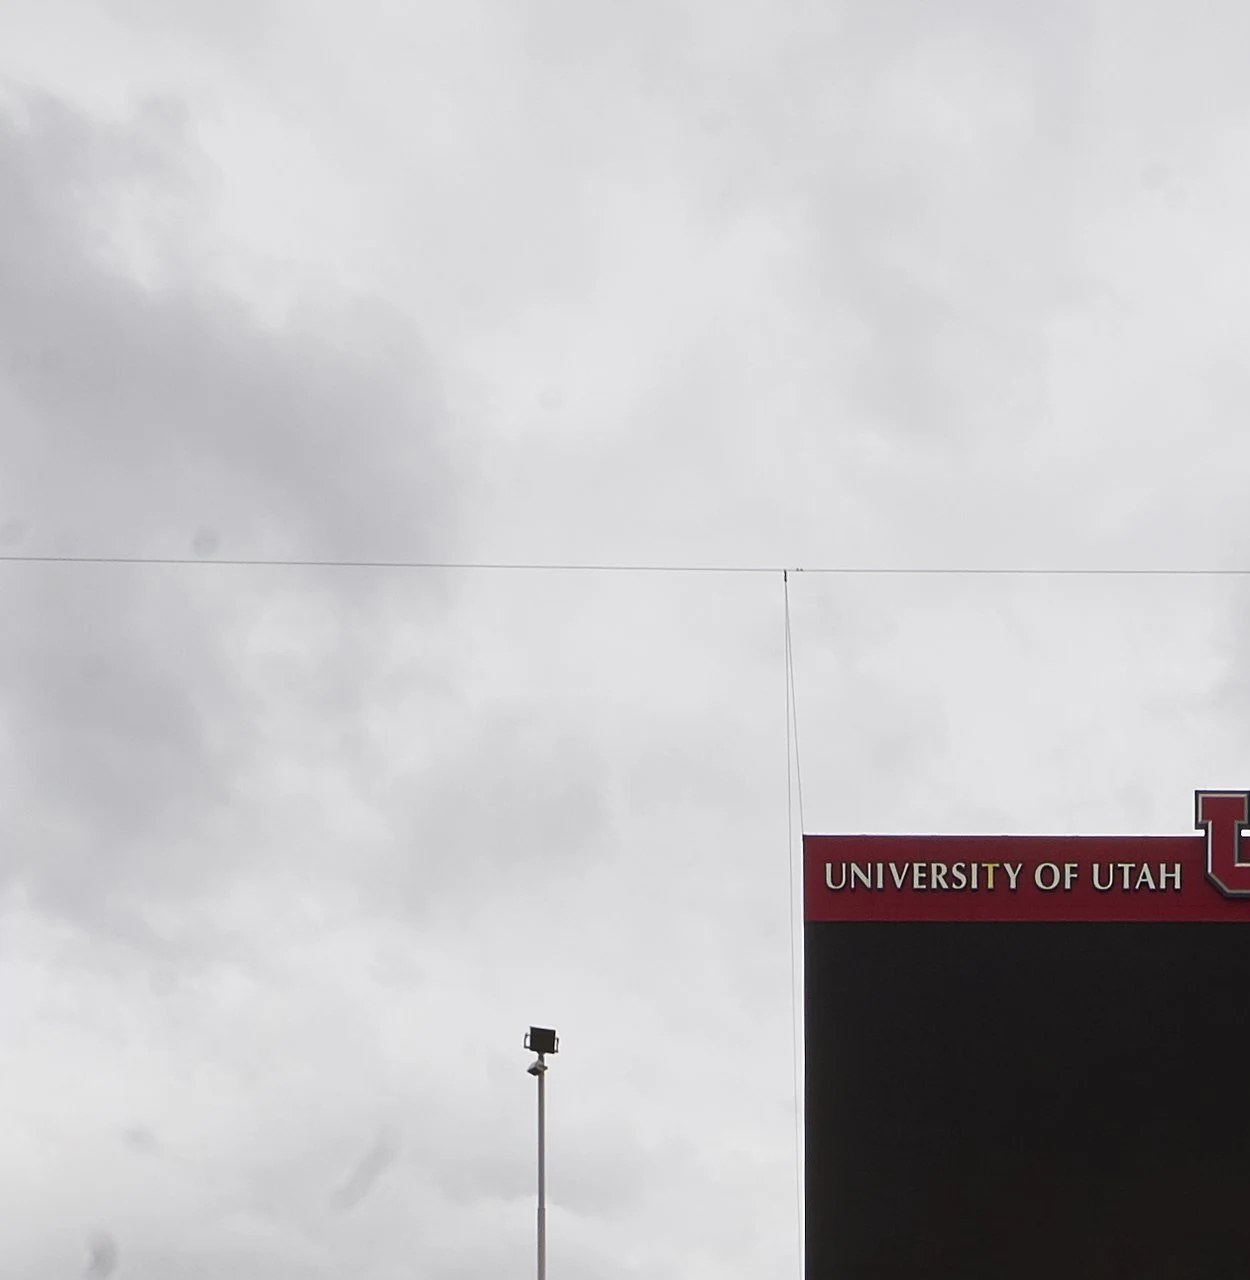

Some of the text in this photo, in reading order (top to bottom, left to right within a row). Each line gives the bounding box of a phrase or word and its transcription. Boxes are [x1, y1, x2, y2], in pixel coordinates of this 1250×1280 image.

[825, 862, 1181, 890] UNIVERSITY OF UTAH
